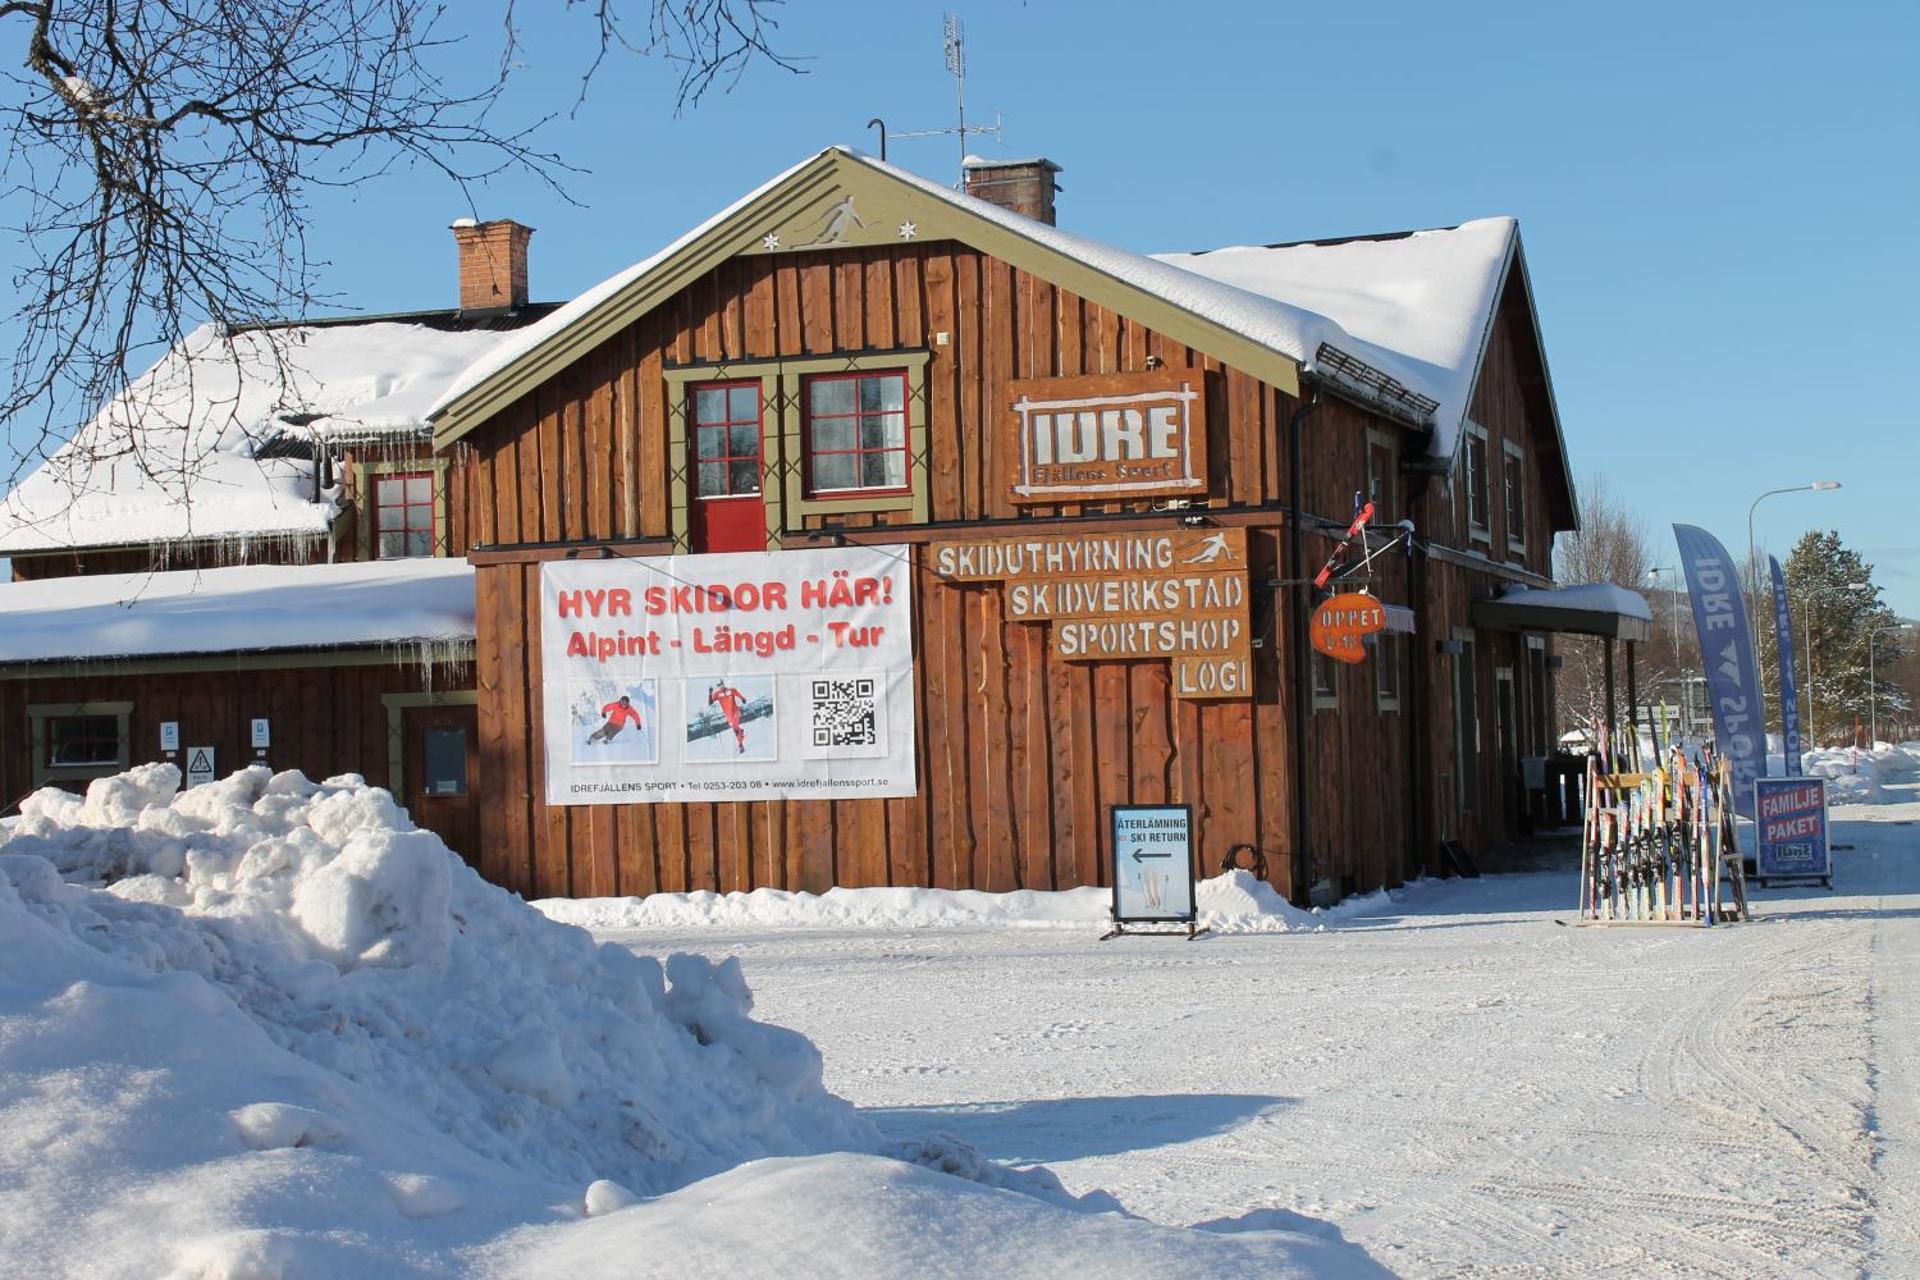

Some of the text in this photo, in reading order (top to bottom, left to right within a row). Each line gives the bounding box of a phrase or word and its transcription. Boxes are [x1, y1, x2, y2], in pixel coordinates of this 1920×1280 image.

[1034, 406, 1178, 465] IDRE
[938, 537, 1172, 577] SKIDUTHYRNING
[558, 569, 893, 618] HYR SKIDOR HÄR!
[1010, 577, 1242, 615] SKIDVERKSTAD
[567, 629, 661, 663] Alpint
[693, 624, 796, 658] Längd
[828, 621, 885, 648] Tur
[1058, 618, 1240, 654] SPORTSHOP
[1178, 660, 1246, 694] LOGI
[644, 781, 677, 791] SPORT
[688, 780, 701, 790] Tel
[1762, 787, 1819, 817] FAMILJE
[1130, 832, 1186, 843] SKI RETURN
[1767, 816, 1816, 841] PAKET
